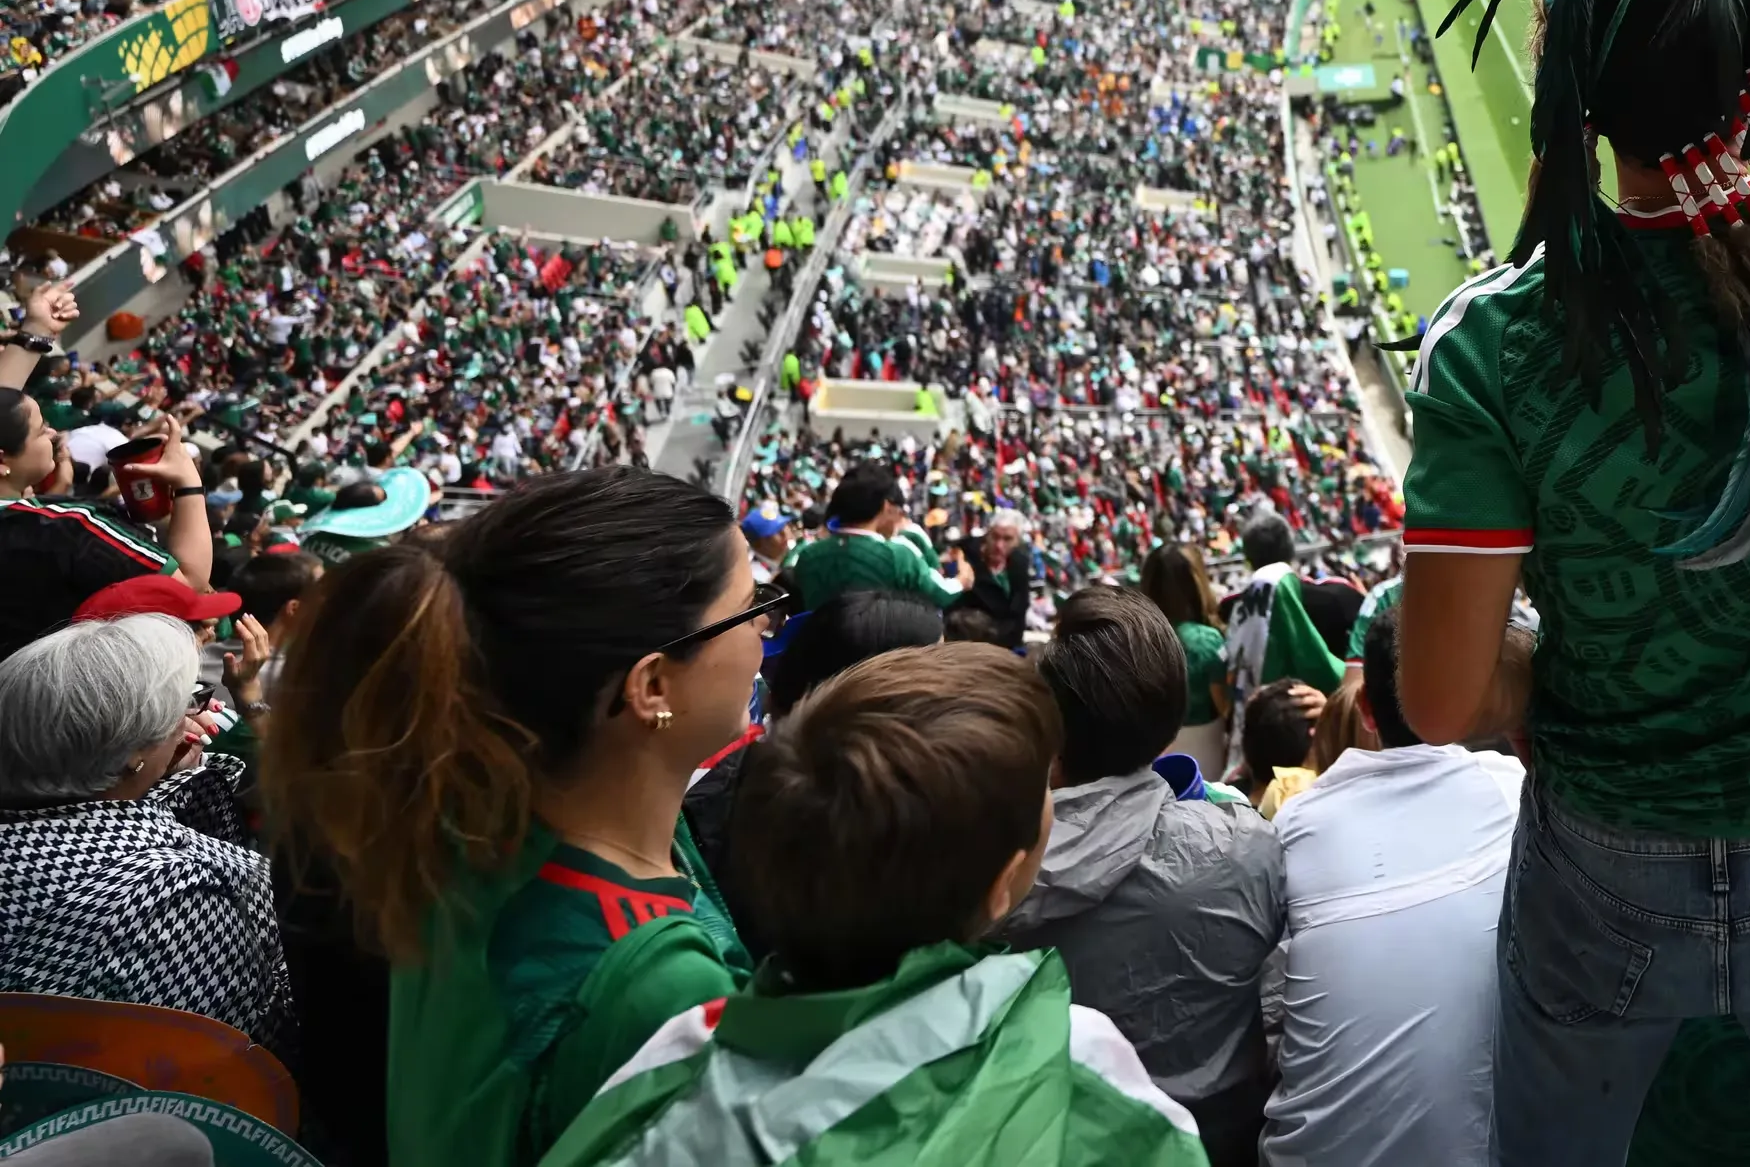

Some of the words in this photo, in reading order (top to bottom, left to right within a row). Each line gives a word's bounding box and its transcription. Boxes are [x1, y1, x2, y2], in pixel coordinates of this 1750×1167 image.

[35, 1109, 81, 1142] FIFA
[150, 1096, 186, 1116] FIFA
[250, 1126, 288, 1160] FIFA
